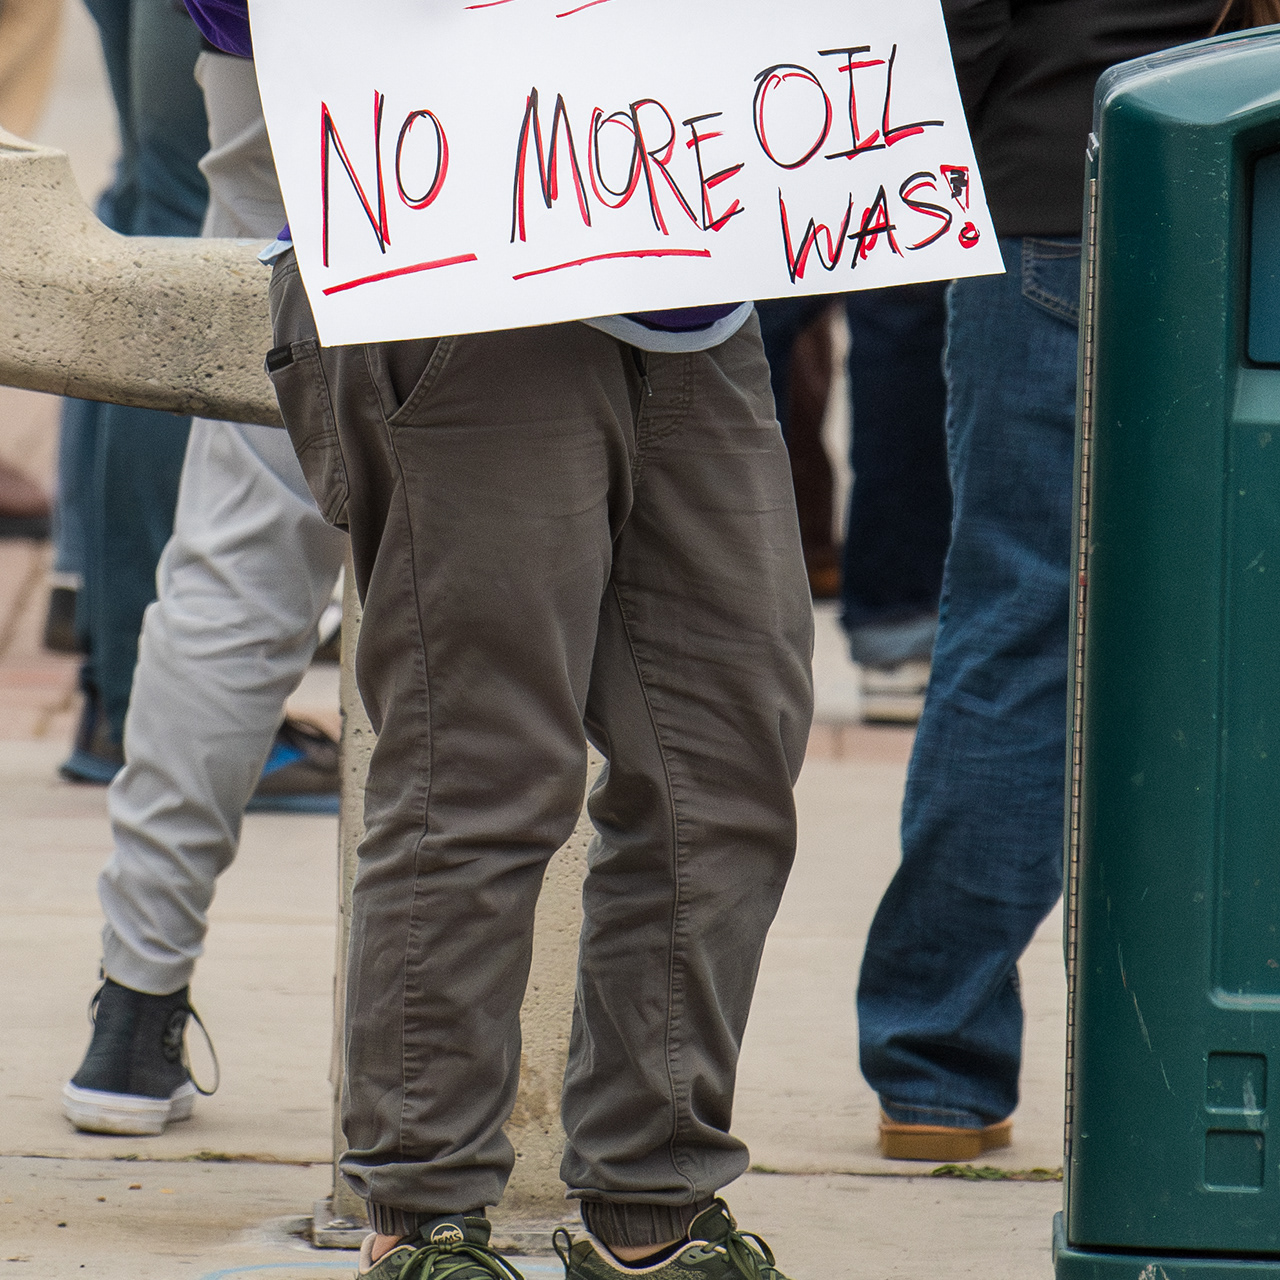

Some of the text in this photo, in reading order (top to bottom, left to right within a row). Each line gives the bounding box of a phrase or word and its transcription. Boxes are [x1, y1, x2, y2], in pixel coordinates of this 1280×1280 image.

[320, 44, 945, 268] NO MORE OIL
